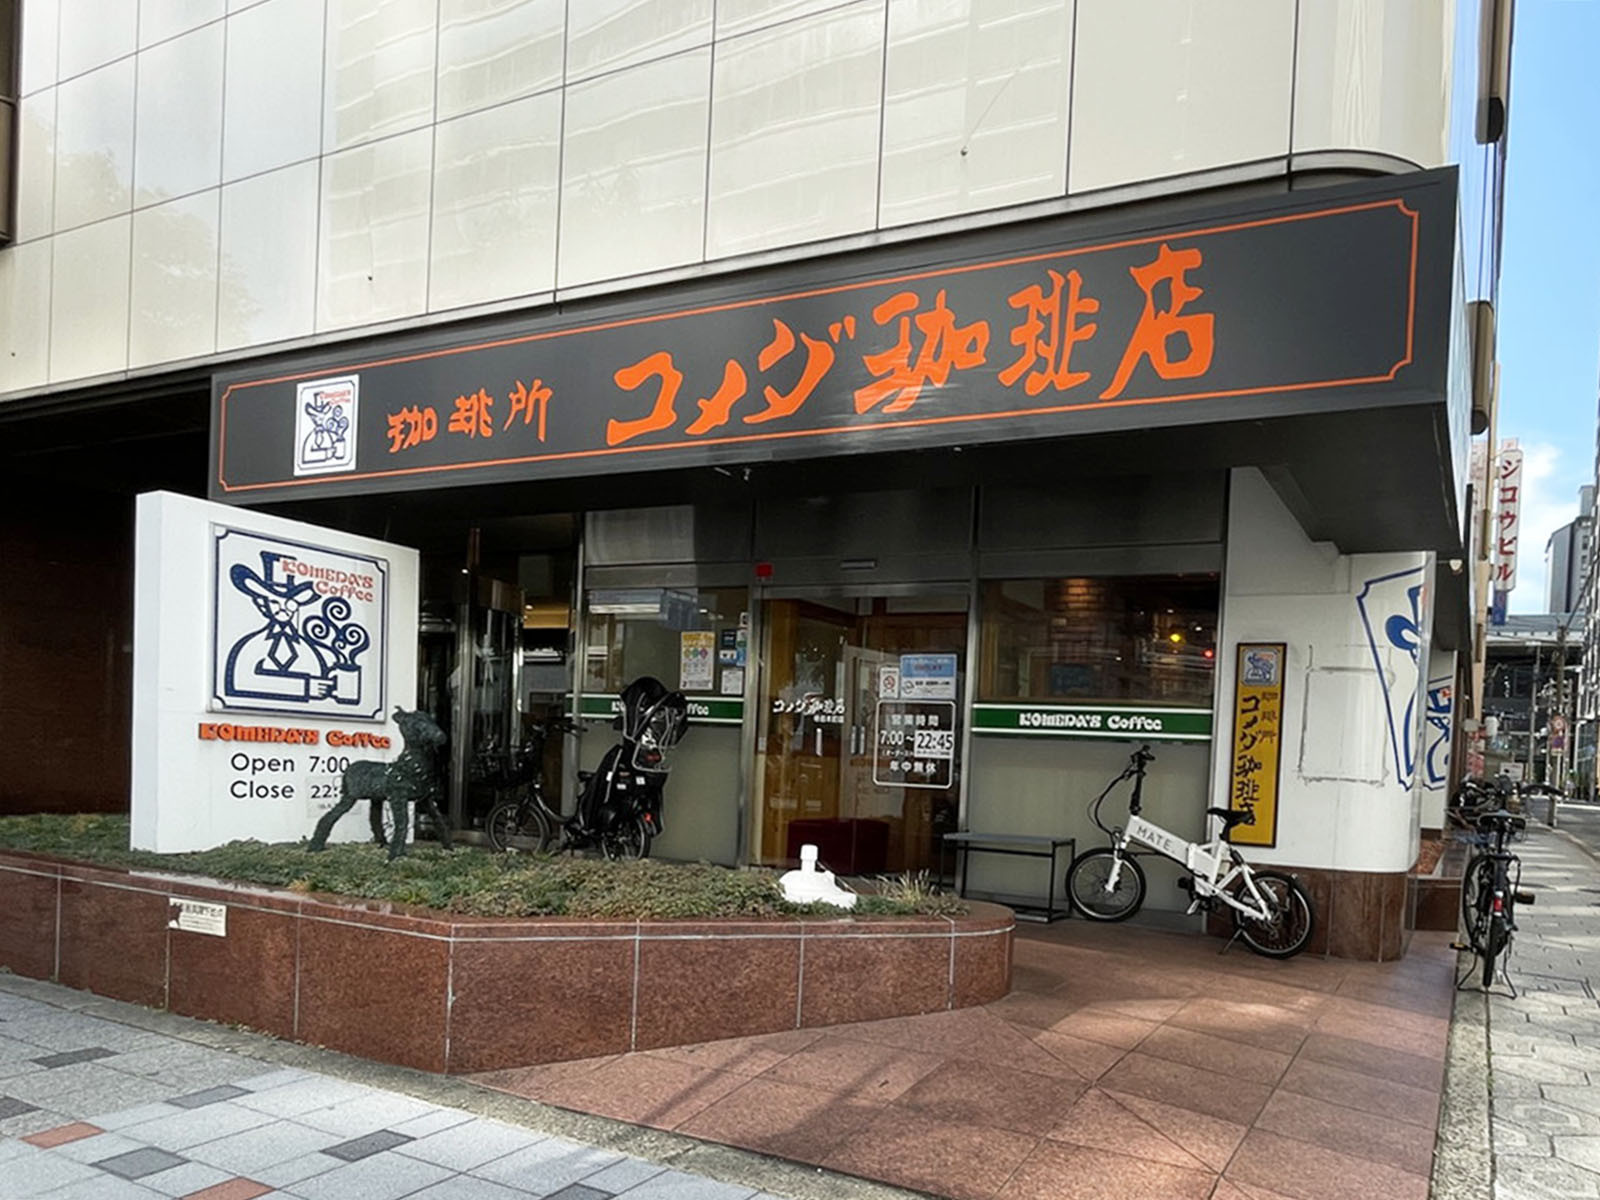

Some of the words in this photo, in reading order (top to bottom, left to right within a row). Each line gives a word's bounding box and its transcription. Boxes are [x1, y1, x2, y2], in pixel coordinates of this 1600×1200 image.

[606, 243, 1215, 446] コメダ珈琲店
[282, 560, 374, 590] KOMEDA'S
[315, 580, 374, 603] Coffee
[1018, 712, 1102, 728] KOMEDA'S
[1106, 715, 1163, 731] Coffee
[198, 722, 320, 746] KOMEDA'S
[325, 730, 392, 750] Coffee
[230, 752, 295, 776] Open
[308, 756, 350, 774] 7:00
[230, 779, 295, 799] Close
[310, 784, 344, 799] 22:
